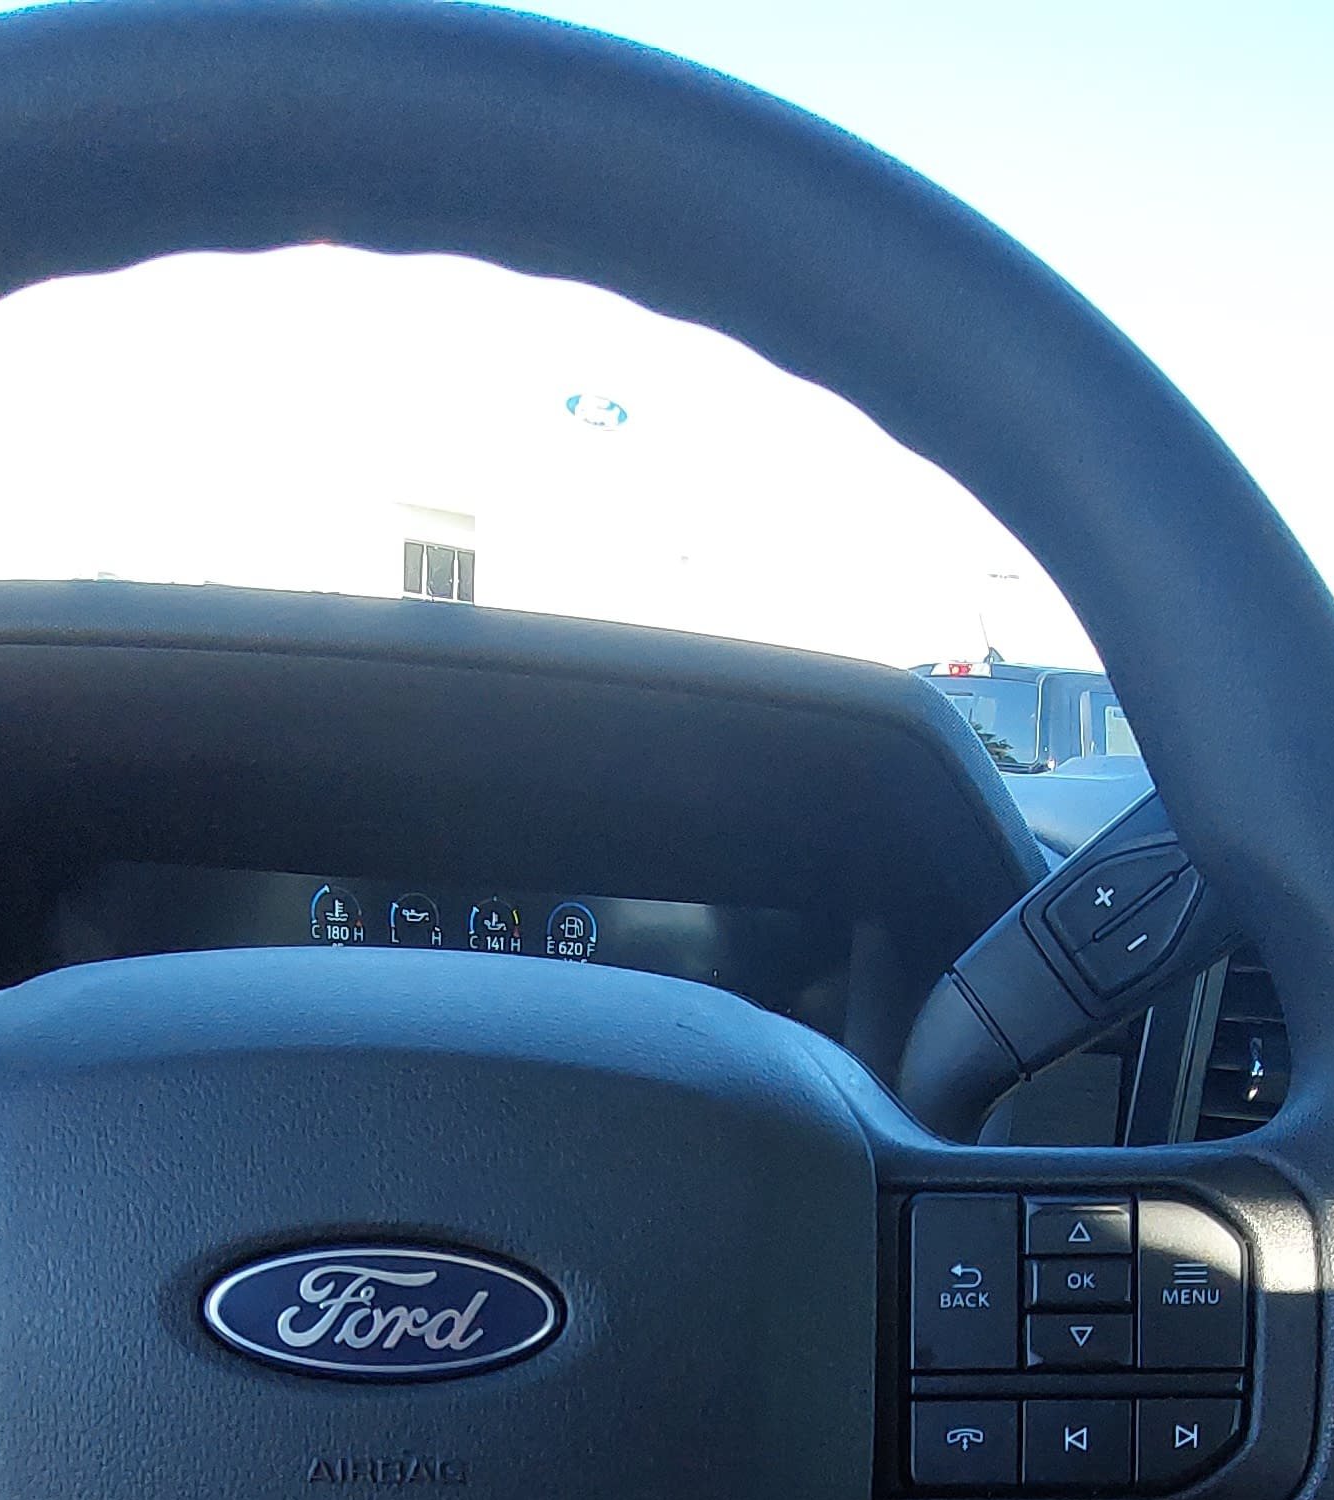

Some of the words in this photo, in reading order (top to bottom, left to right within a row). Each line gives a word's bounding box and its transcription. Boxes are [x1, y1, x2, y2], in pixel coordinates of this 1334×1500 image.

[311, 925, 321, 939] C
[327, 925, 350, 941] 180
[353, 927, 364, 942] H
[391, 928, 400, 943] L
[431, 931, 442, 946] H
[469, 935, 479, 949] C
[486, 936, 505, 951] 141
[510, 938, 521, 952] H
[547, 941, 555, 955] E
[558, 942, 584, 956] 620
[586, 943, 596, 957] F
[1067, 1272, 1096, 1290] OK
[939, 1291, 991, 1310] BACK
[1161, 1288, 1221, 1306] MENU
[276, 1264, 490, 1352] Ford
